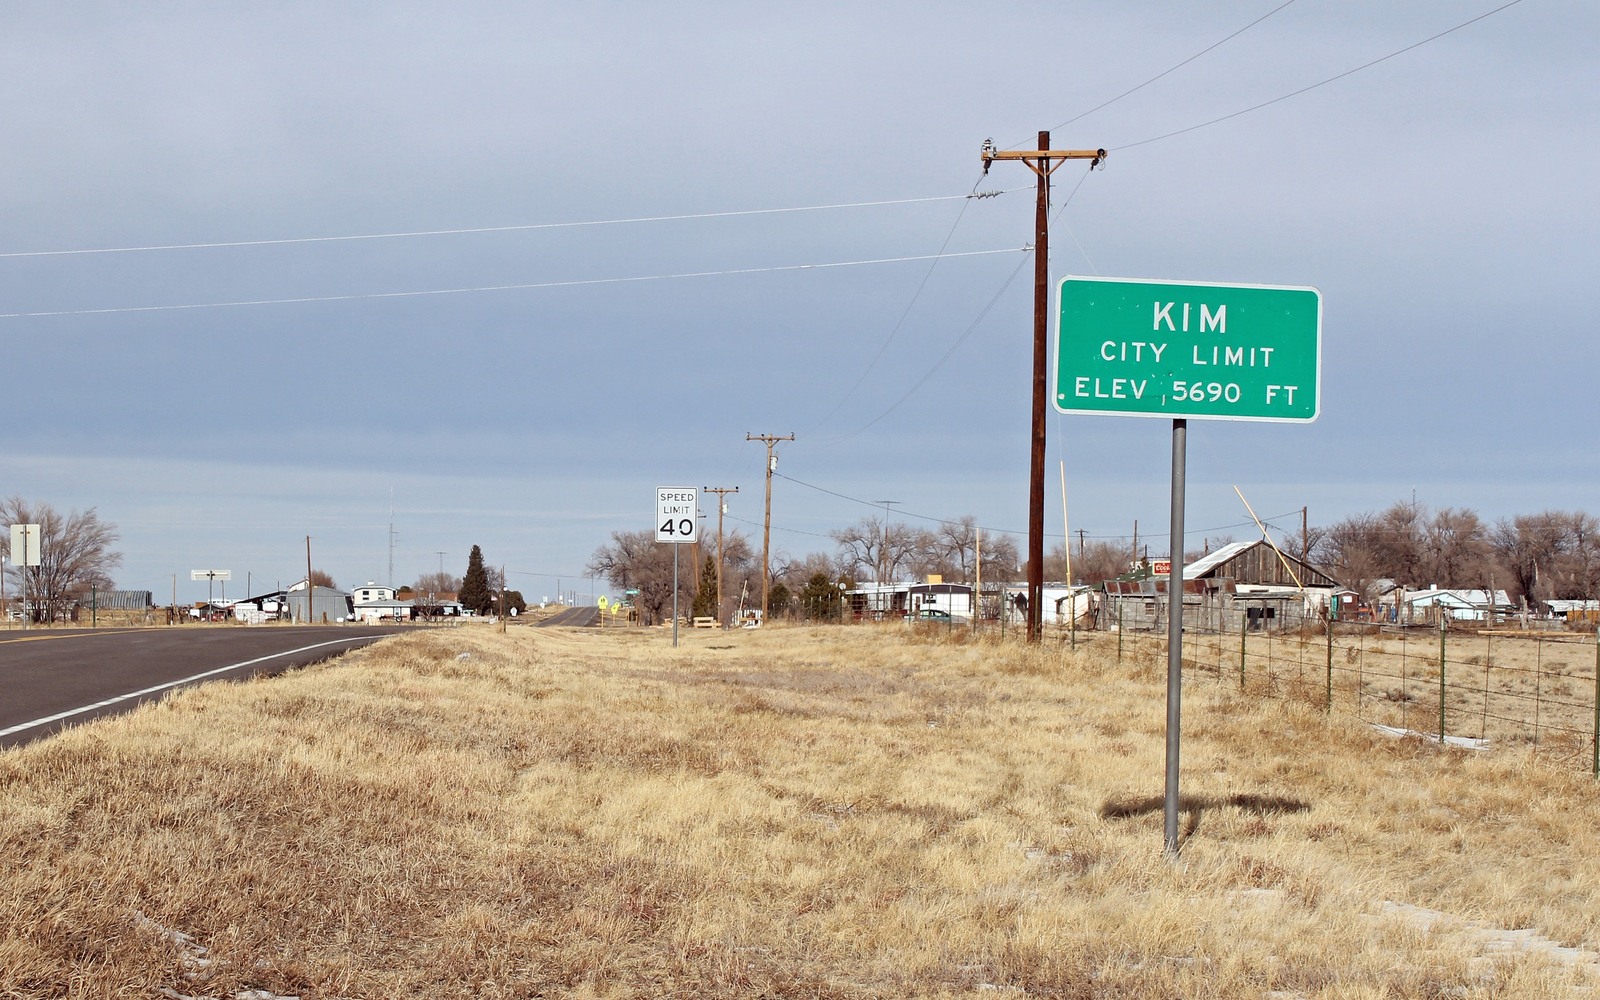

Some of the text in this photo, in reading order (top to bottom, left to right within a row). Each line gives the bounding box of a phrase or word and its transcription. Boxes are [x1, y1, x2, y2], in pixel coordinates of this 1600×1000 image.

[1153, 301, 1227, 334] KIM
[1100, 341, 1274, 368] CITY LIMIT
[1075, 377, 1298, 406] ELEV 5690 FT
[660, 493, 694, 502] SPEED
[663, 506, 690, 514] LIMIT
[660, 518, 693, 536] 40
